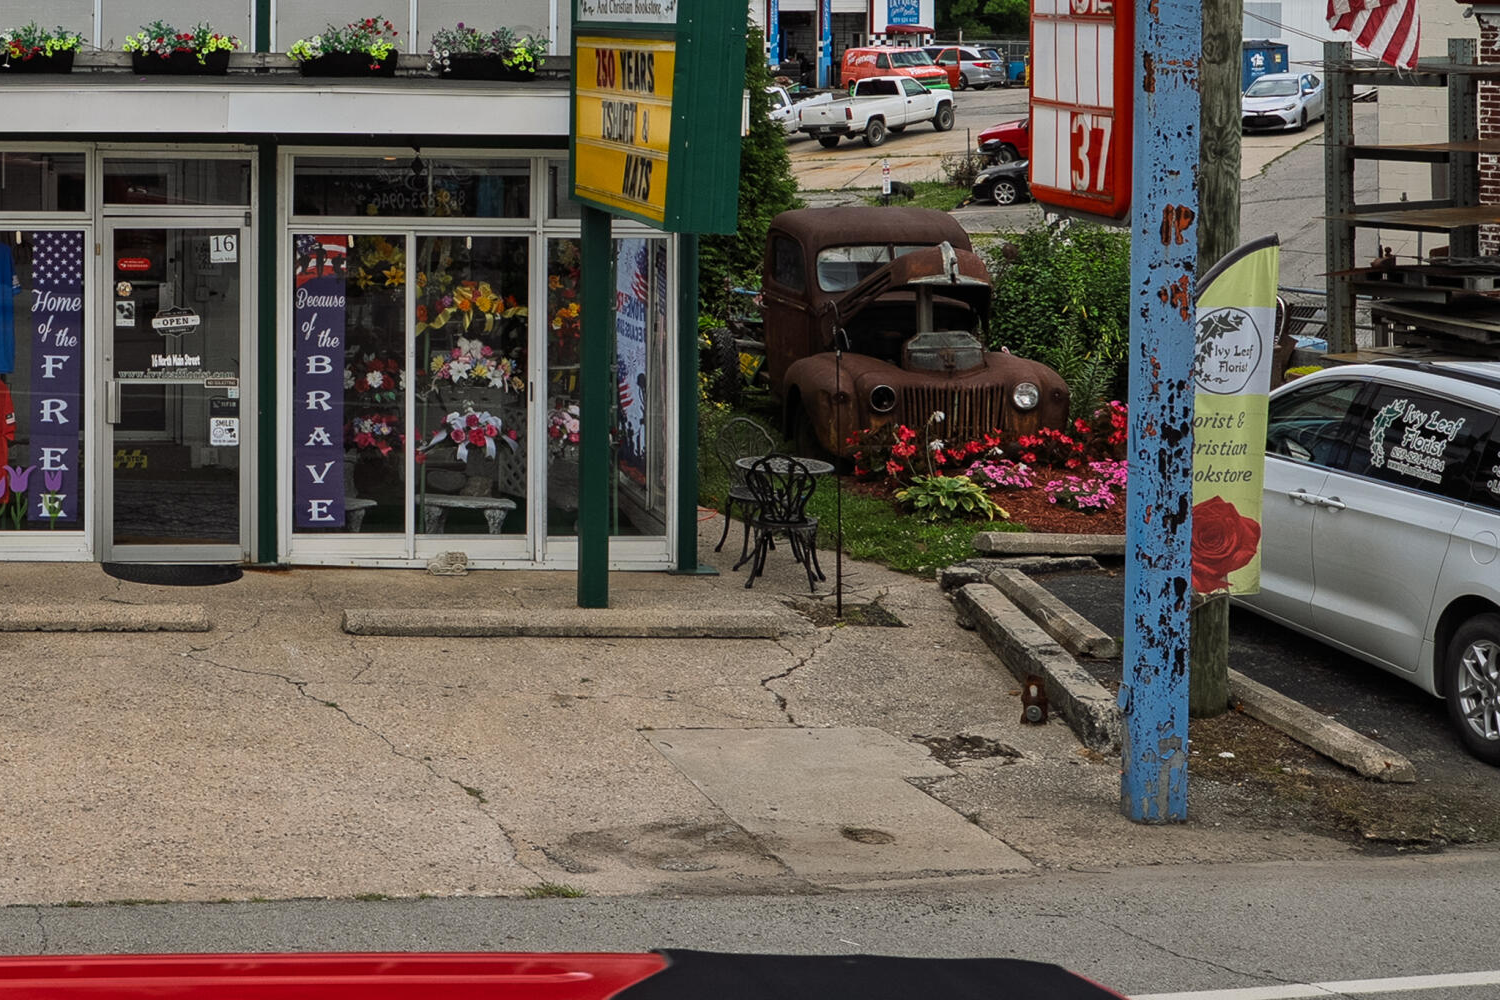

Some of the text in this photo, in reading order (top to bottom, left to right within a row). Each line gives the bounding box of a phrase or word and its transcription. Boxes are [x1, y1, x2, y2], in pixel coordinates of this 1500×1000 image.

[595, 47, 655, 93] 250 YEARS
[602, 101, 650, 145] TSHIRT &
[1072, 112, 1113, 192] 37
[622, 154, 653, 201] HATS
[213, 234, 234, 253] 16
[31, 289, 82, 312] Home
[296, 288, 345, 309] Because
[38, 315, 54, 342] of
[162, 317, 189, 326] OPEN
[301, 312, 318, 340] of
[55, 327, 78, 347] the
[317, 328, 340, 348] the
[185, 354, 200, 366] Street
[1214, 345, 1254, 359] Ivy Leaf
[1219, 361, 1248, 373] Florist
[1194, 411, 1246, 429] orist &
[1403, 404, 1466, 442] Ivy Leaf
[37, 355, 70, 518] FREE
[304, 354, 336, 522] BRAVE
[1193, 439, 1248, 456] ristian
[1401, 426, 1447, 457] Florist
[1194, 464, 1253, 483] okstore
